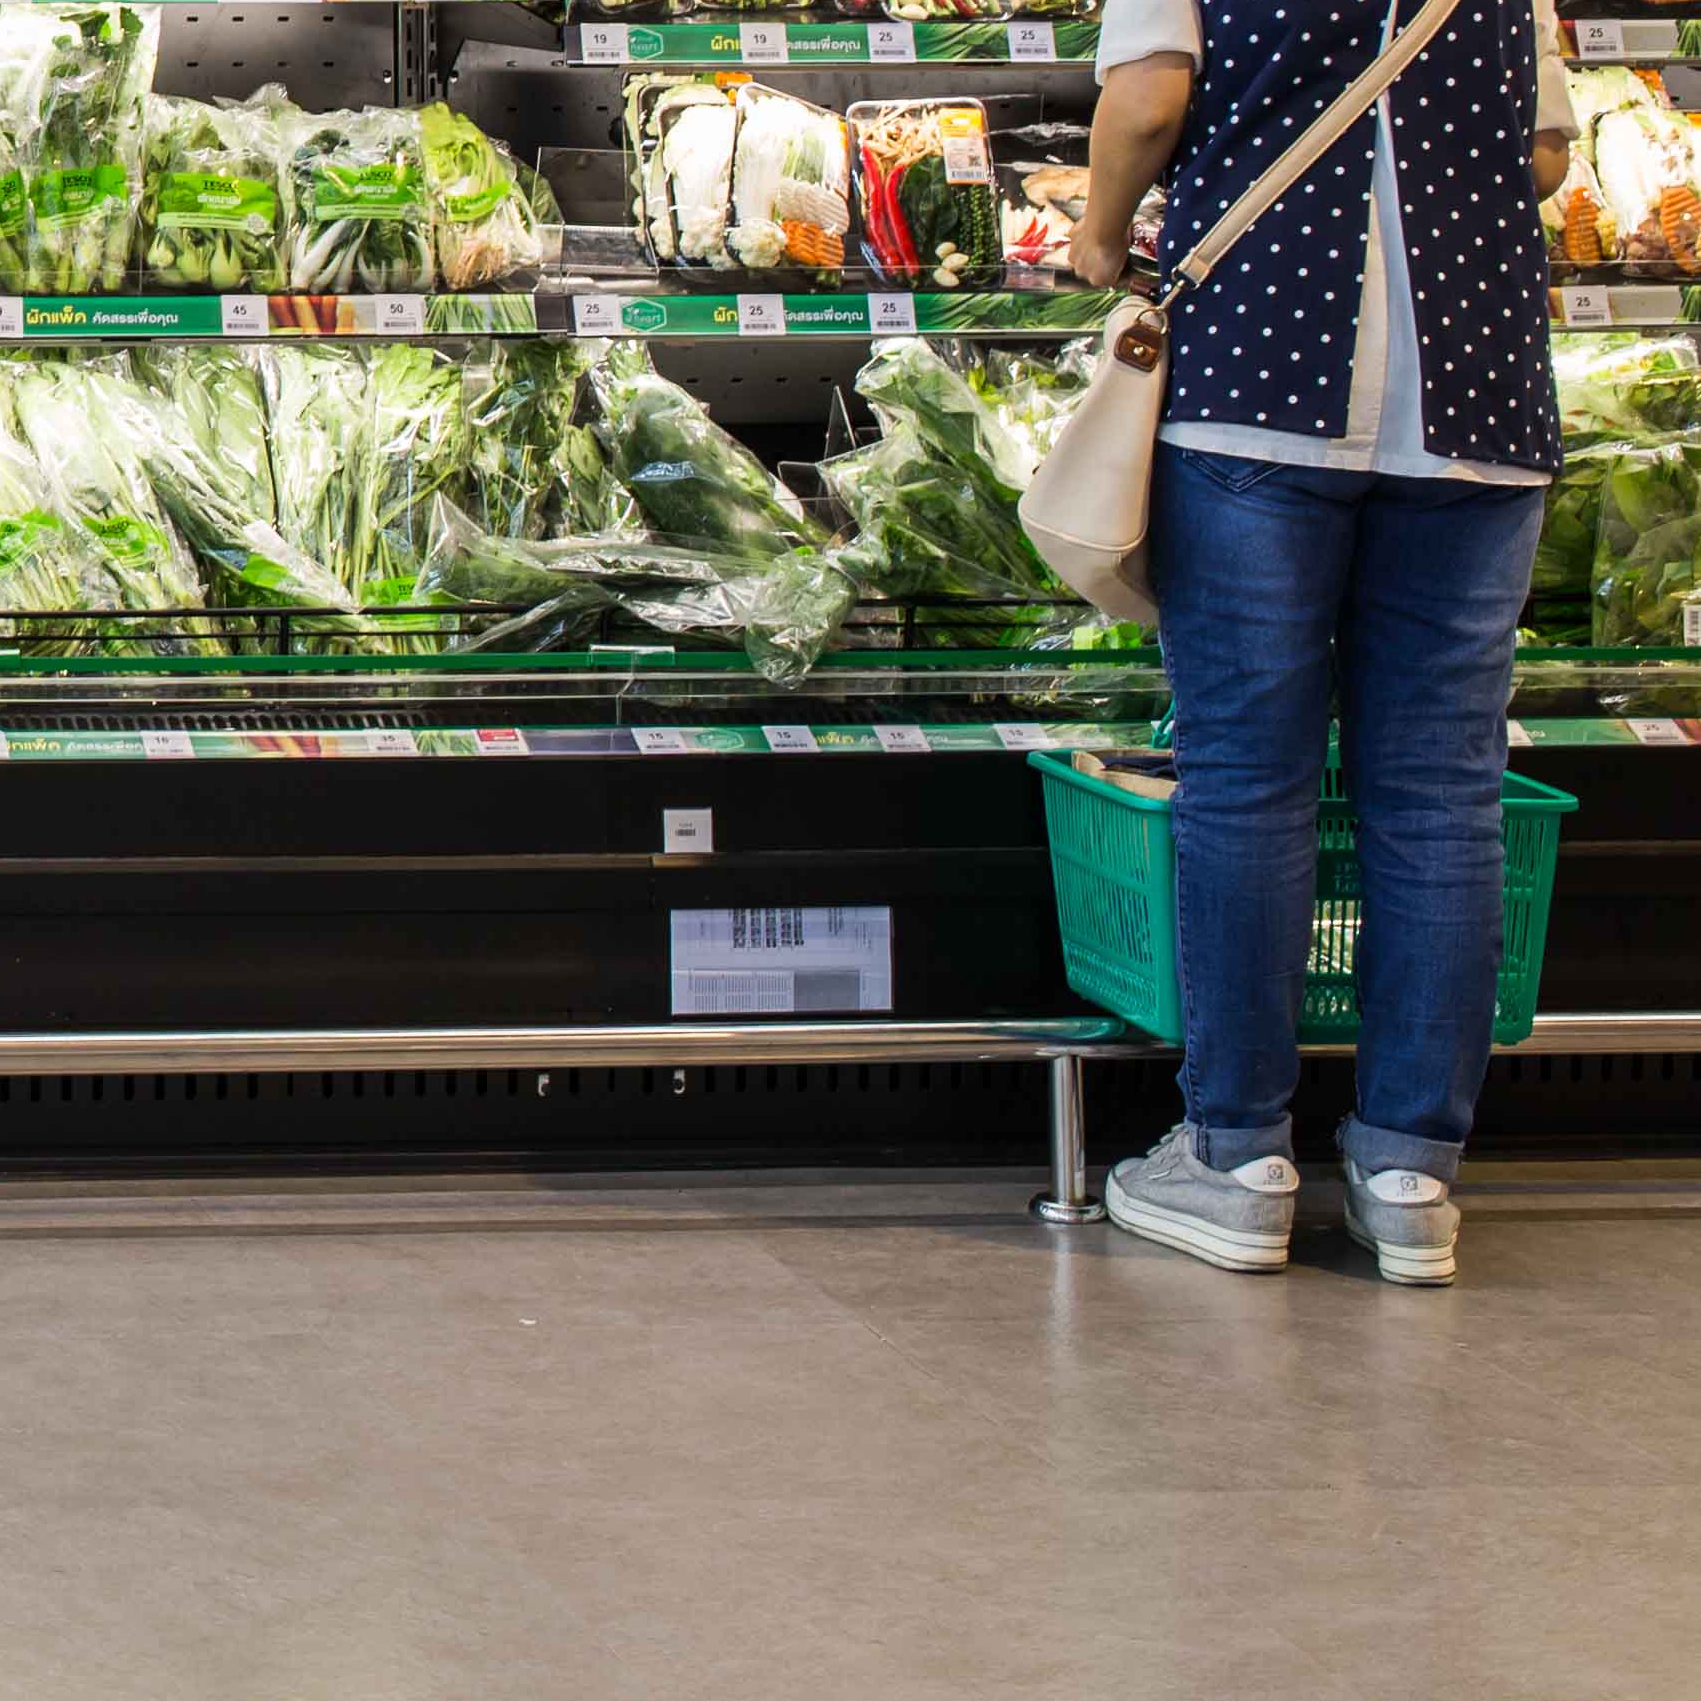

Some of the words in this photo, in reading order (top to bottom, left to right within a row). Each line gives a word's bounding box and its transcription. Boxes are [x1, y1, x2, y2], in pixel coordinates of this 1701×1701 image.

[879, 32, 892, 41] 25
[1021, 30, 1034, 40] 25
[1590, 28, 1603, 37] 25
[594, 34, 606, 43] 19
[754, 34, 766, 43] 19
[1576, 297, 1590, 307] 25
[233, 306, 246, 315] 45
[390, 304, 403, 314] 50
[586, 304, 599, 314] 25
[750, 306, 763, 315] 25
[883, 303, 896, 313] 25
[27, 306, 87, 324] ผักแพ็ค
